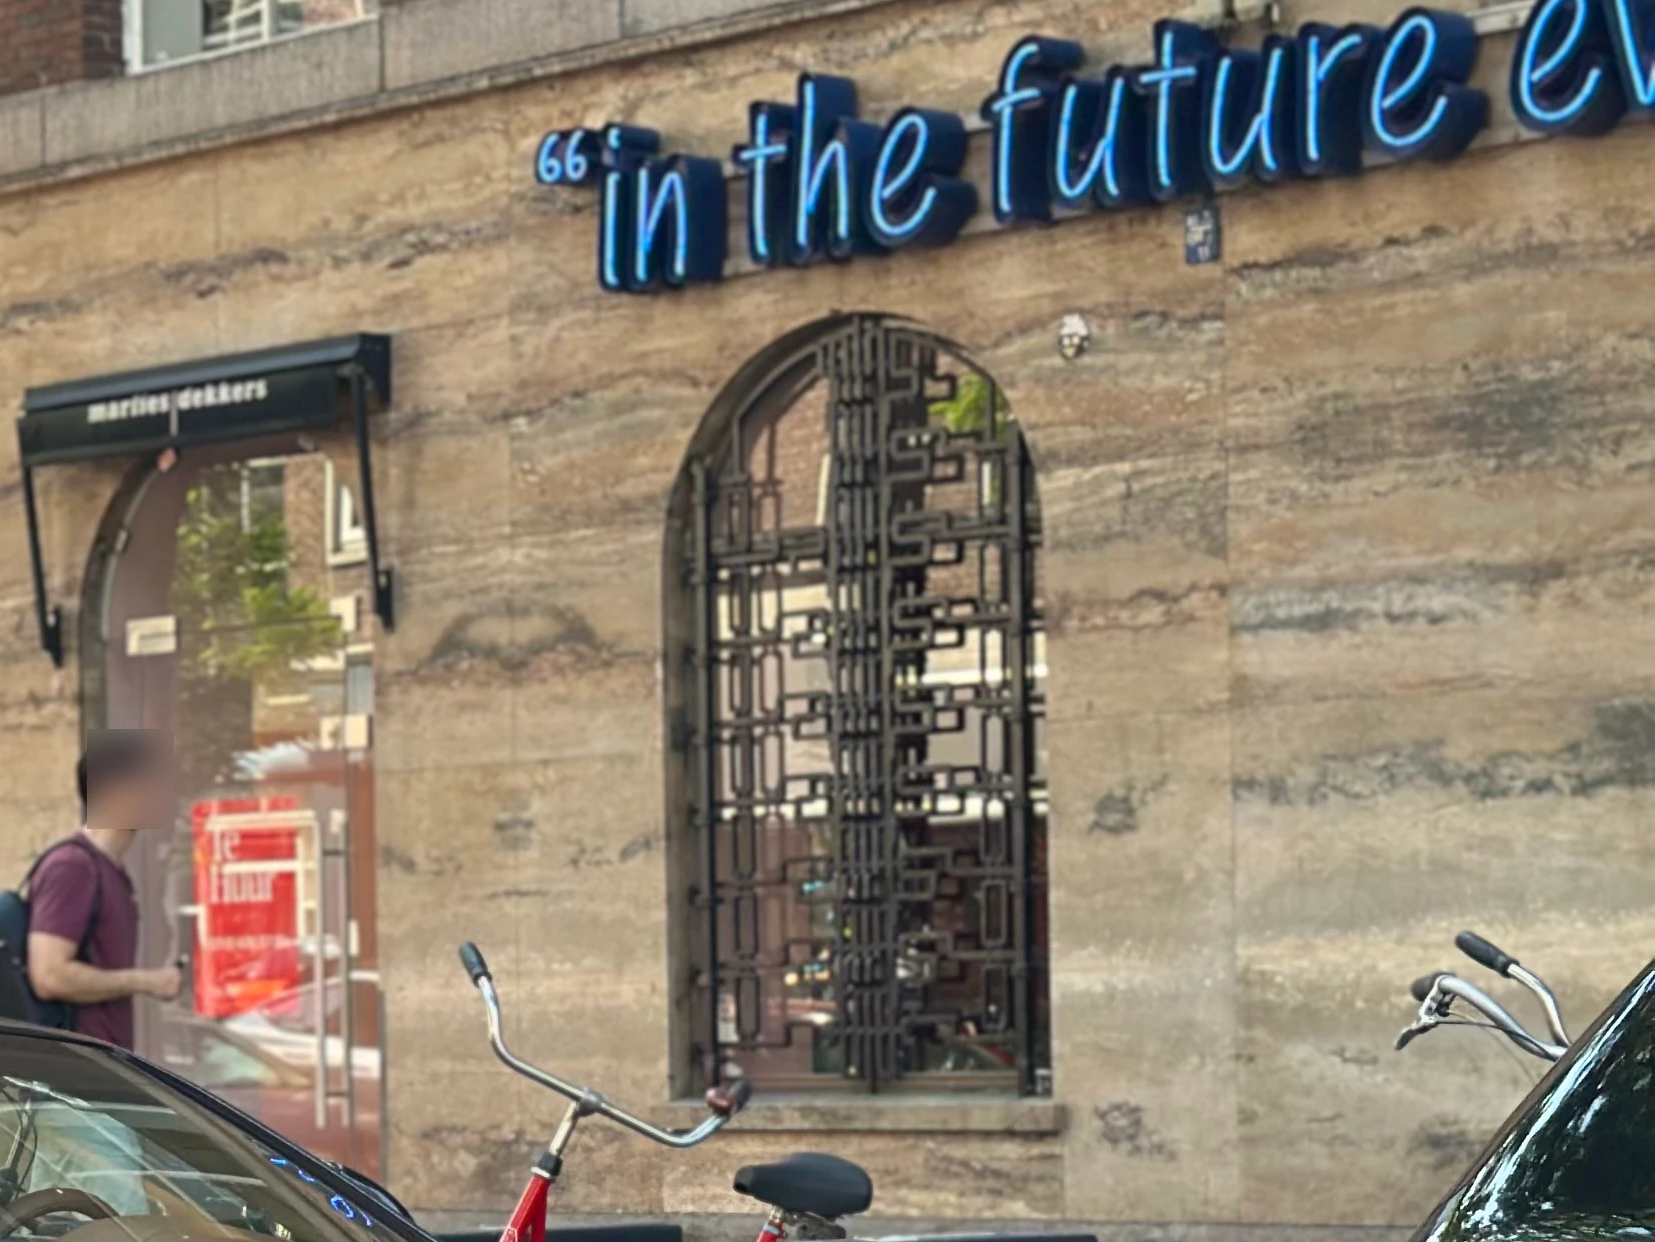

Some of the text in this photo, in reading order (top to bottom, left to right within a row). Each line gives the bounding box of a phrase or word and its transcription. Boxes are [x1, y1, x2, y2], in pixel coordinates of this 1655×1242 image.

[733, 76, 953, 266] the
[983, 8, 1467, 222] future
[177, 379, 268, 410] dekkers
